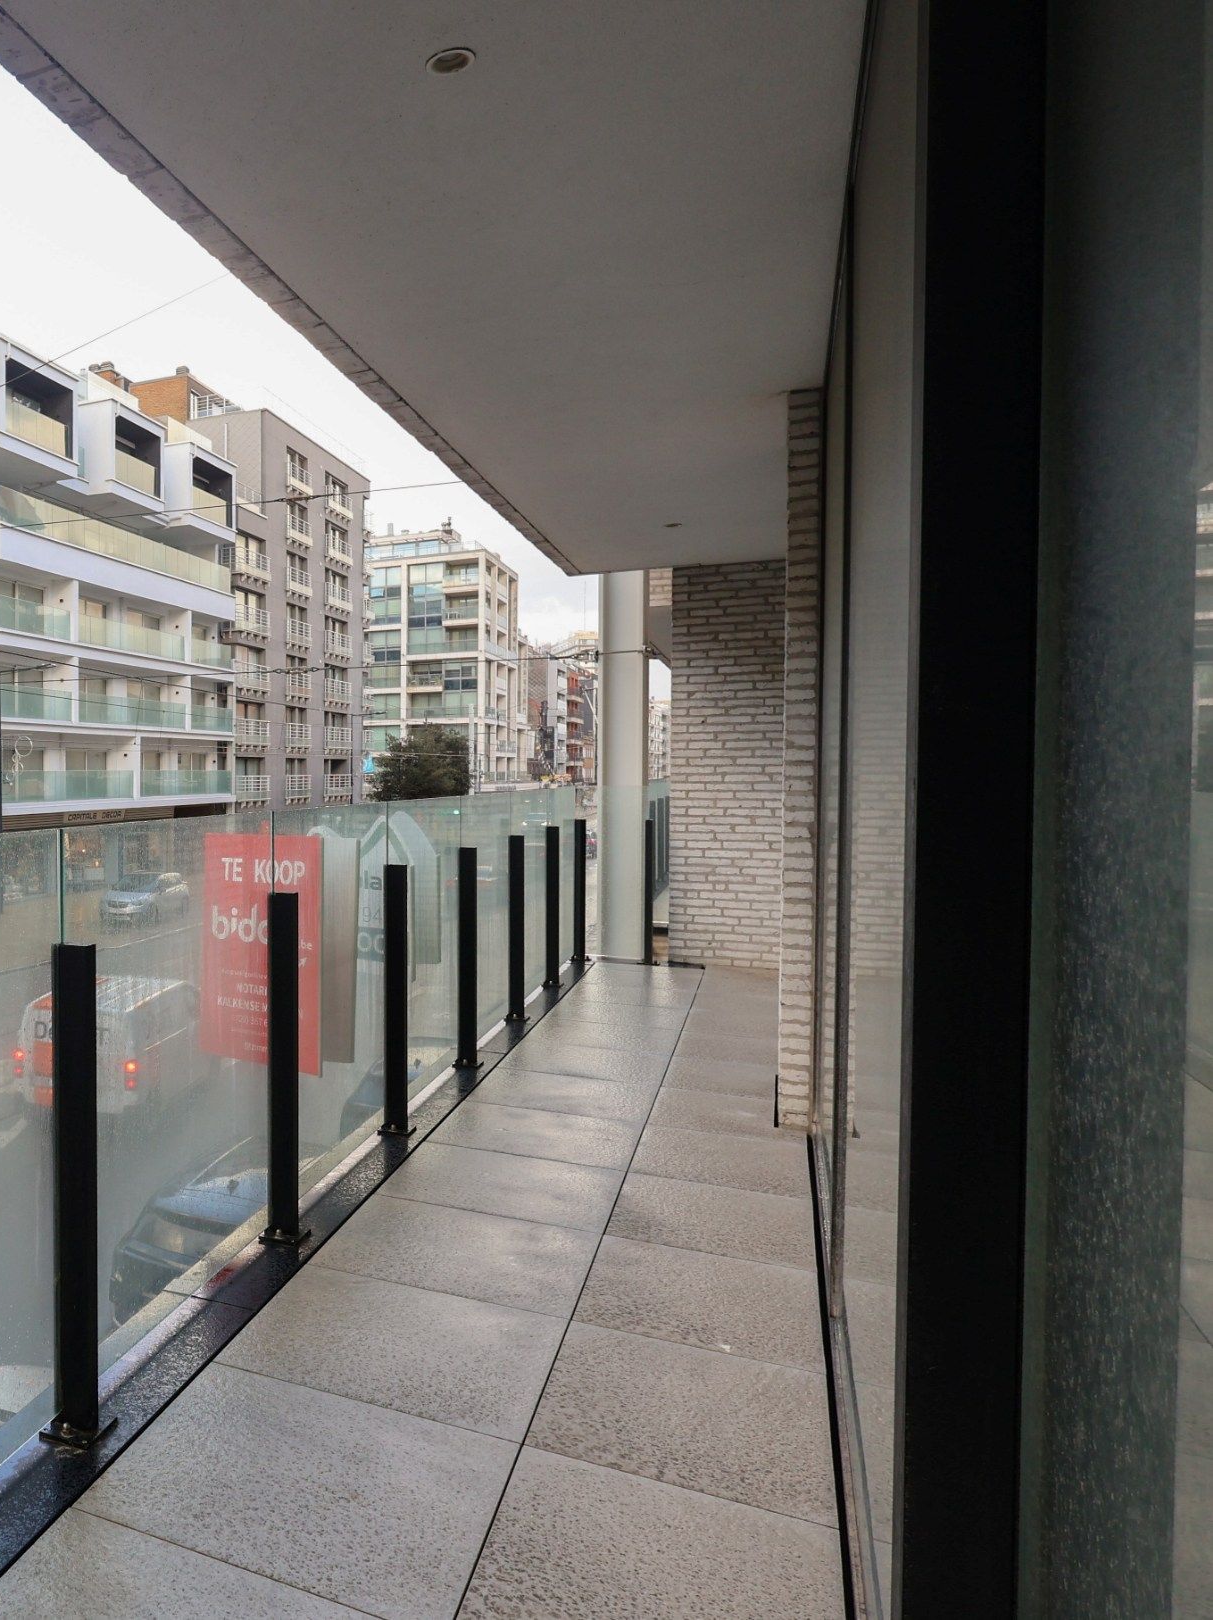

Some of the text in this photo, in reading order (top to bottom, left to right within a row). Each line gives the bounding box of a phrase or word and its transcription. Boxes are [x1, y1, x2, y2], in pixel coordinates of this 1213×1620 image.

[221, 857, 306, 886] TE KOOP
[236, 982, 268, 997] NOTARI
